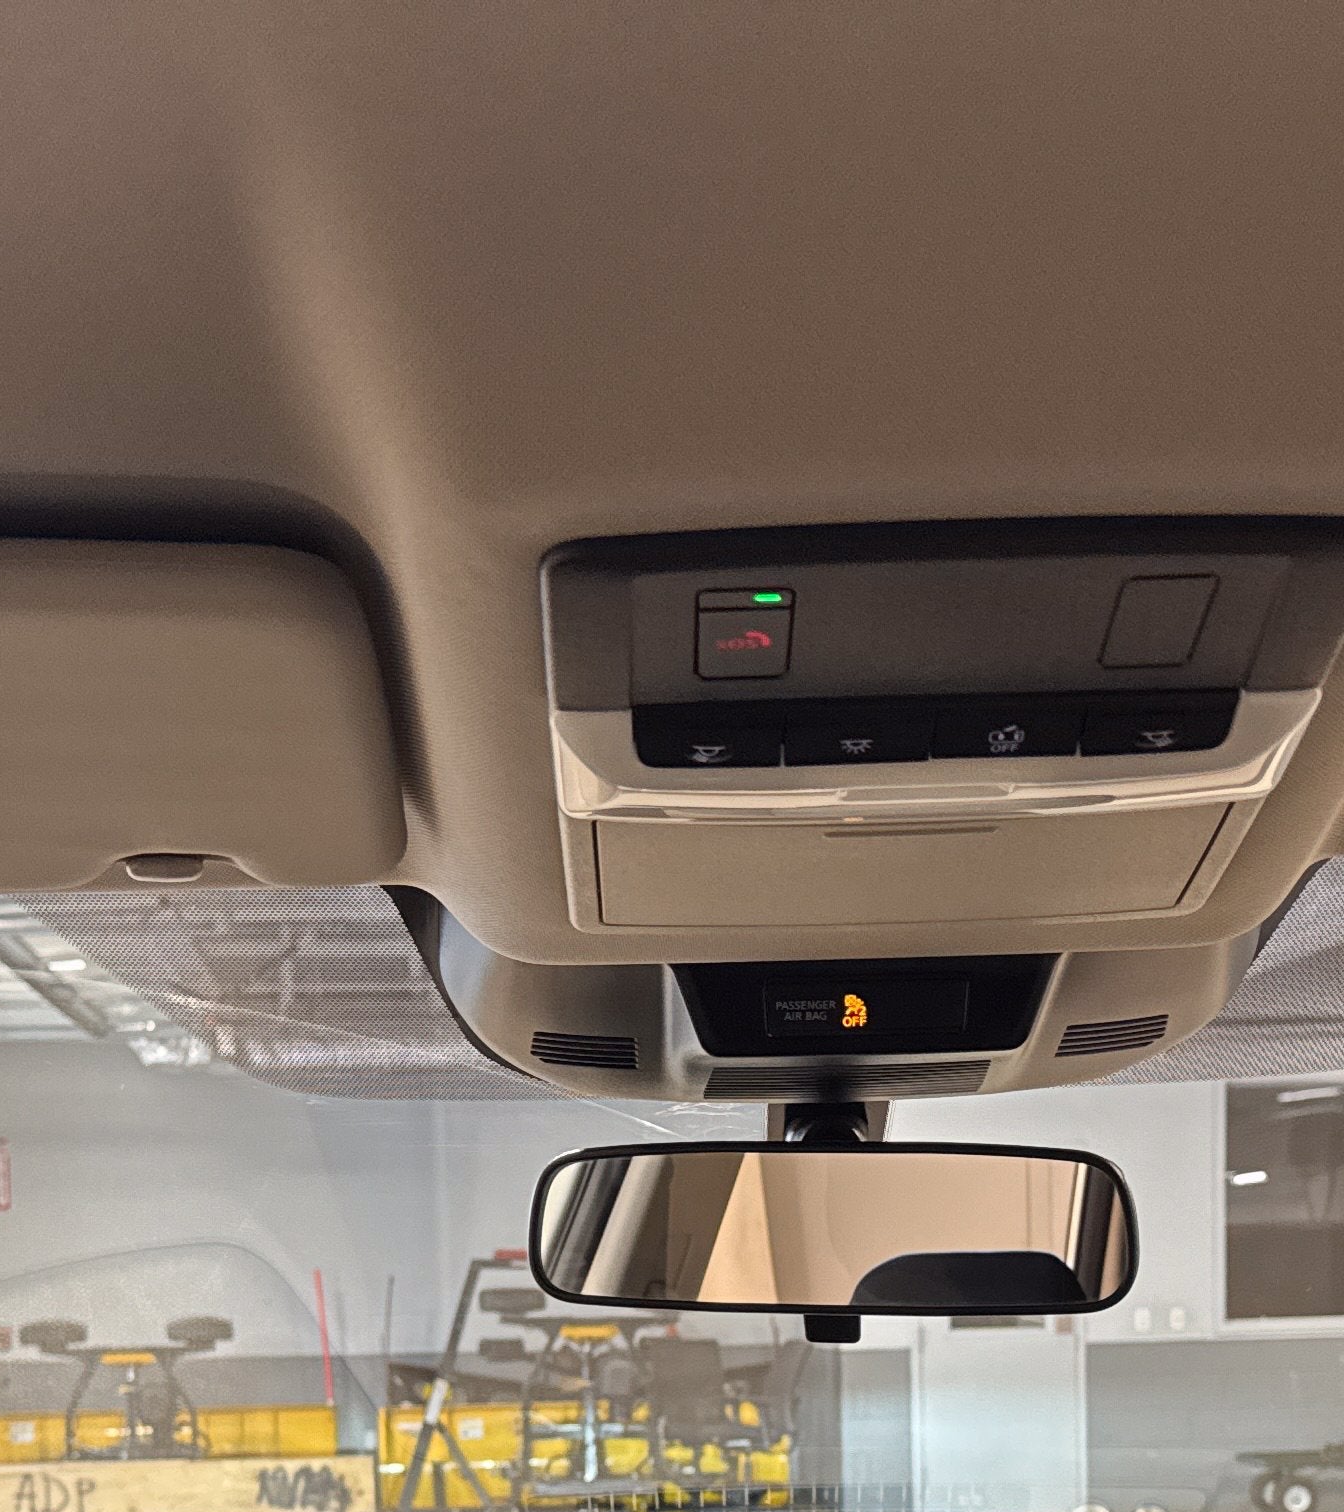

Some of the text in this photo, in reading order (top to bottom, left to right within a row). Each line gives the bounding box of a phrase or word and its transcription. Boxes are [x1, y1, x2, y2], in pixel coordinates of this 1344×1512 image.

[776, 1000, 836, 1010] PASSENGER
[784, 1011, 828, 1021] AIR BAG
[842, 1016, 867, 1028] OFF
